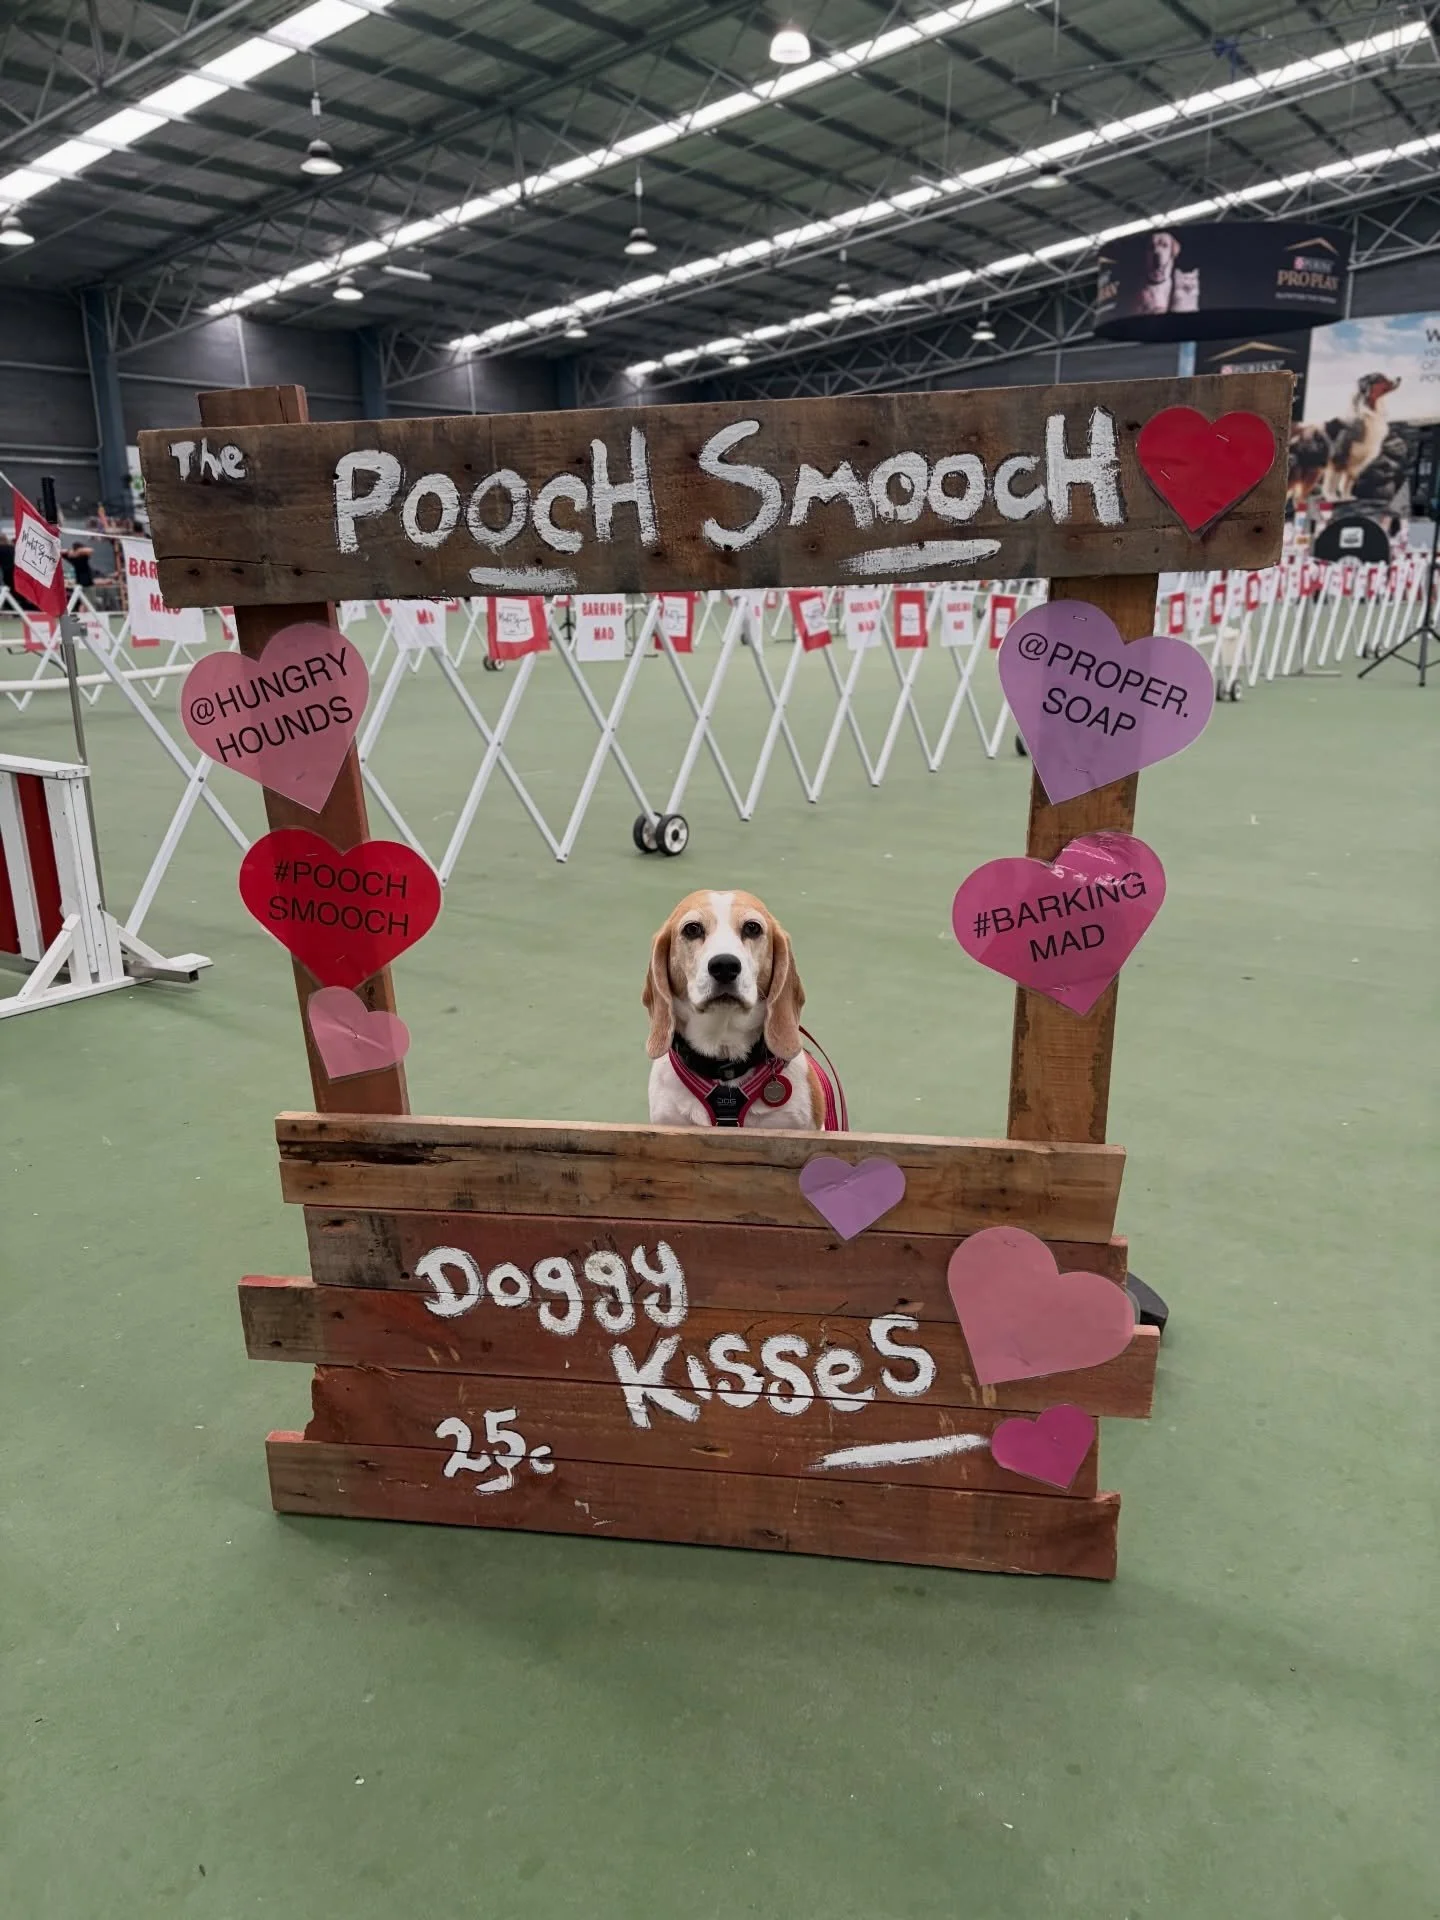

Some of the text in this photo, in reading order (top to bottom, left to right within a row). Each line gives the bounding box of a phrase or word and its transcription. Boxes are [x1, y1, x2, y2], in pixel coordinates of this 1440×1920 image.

[168, 438, 247, 482] The
[582, 602, 623, 617] BARKING
[594, 626, 614, 641] MAD
[190, 647, 348, 725] @HUNGRY
[1018, 632, 1189, 717] @PROPER.
[215, 696, 353, 762] HOUNDS
[1042, 687, 1137, 738] SOAP
[273, 860, 408, 899] #POOCH
[268, 896, 409, 937] SMOOCH
[973, 872, 1147, 938] #BARKING
[1029, 924, 1105, 962] MAD
[414, 1240, 688, 1336] Doggy
